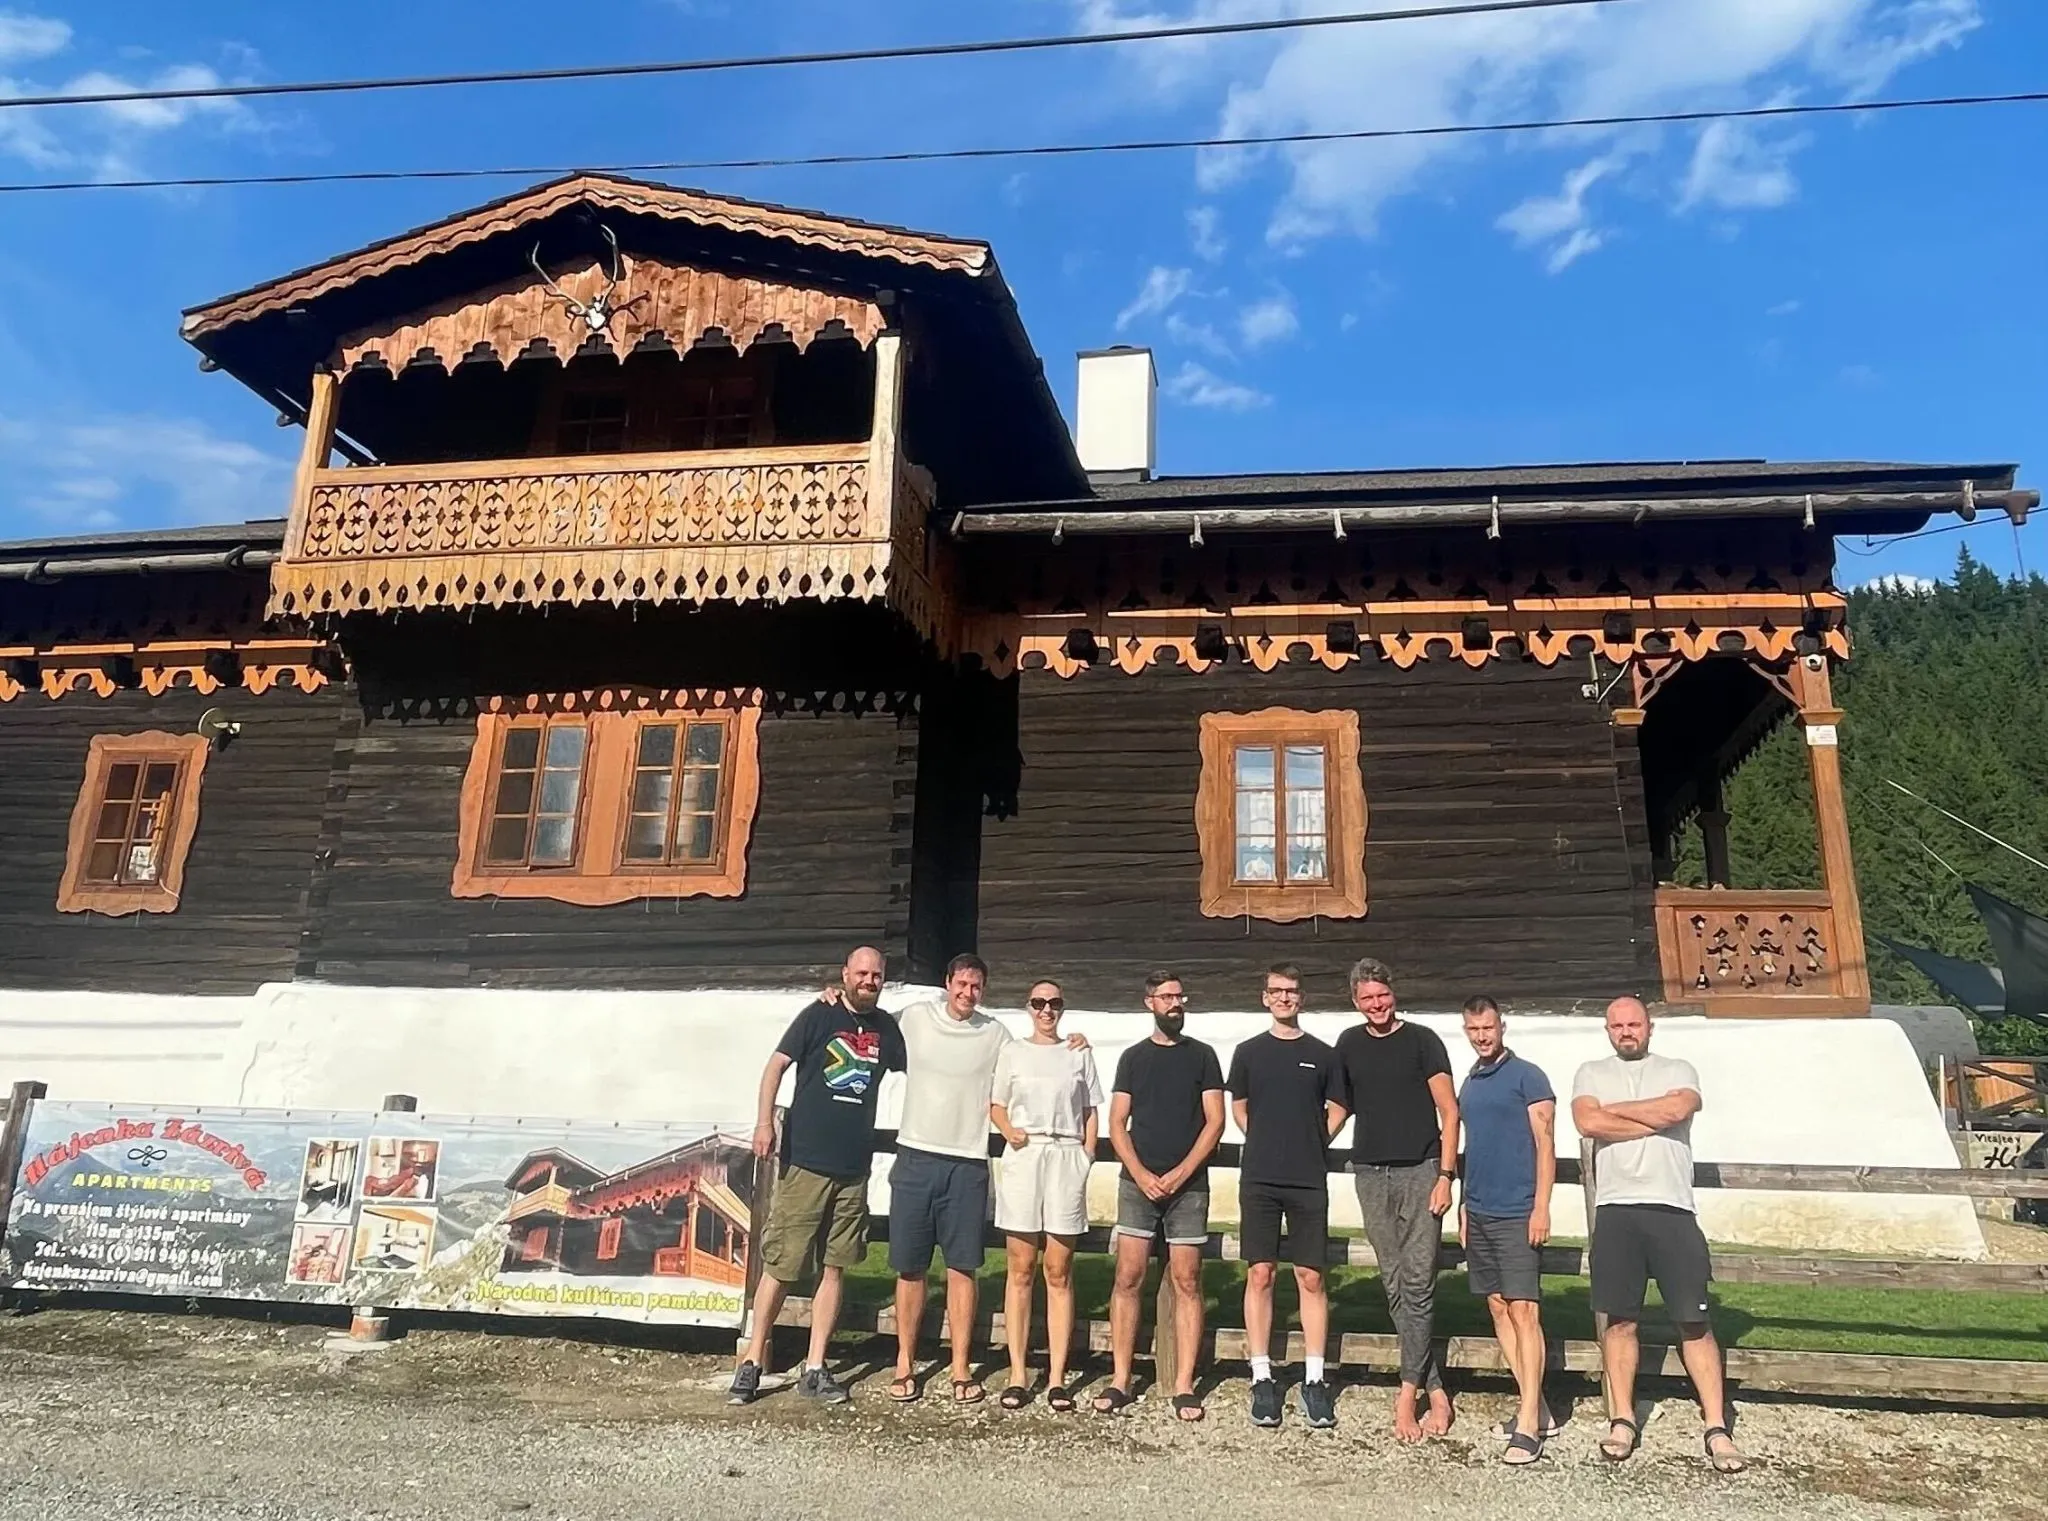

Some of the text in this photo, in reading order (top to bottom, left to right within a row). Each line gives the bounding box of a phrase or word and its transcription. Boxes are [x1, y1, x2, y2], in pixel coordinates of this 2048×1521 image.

[25, 1118, 155, 1188] Hájenka
[72, 1173, 212, 1192] APARTMENTS
[21, 1199, 252, 1228] Na prenájom štýlové apartmány
[35, 1241, 66, 1258] Tel.:
[561, 1284, 643, 1307] kultúrna
